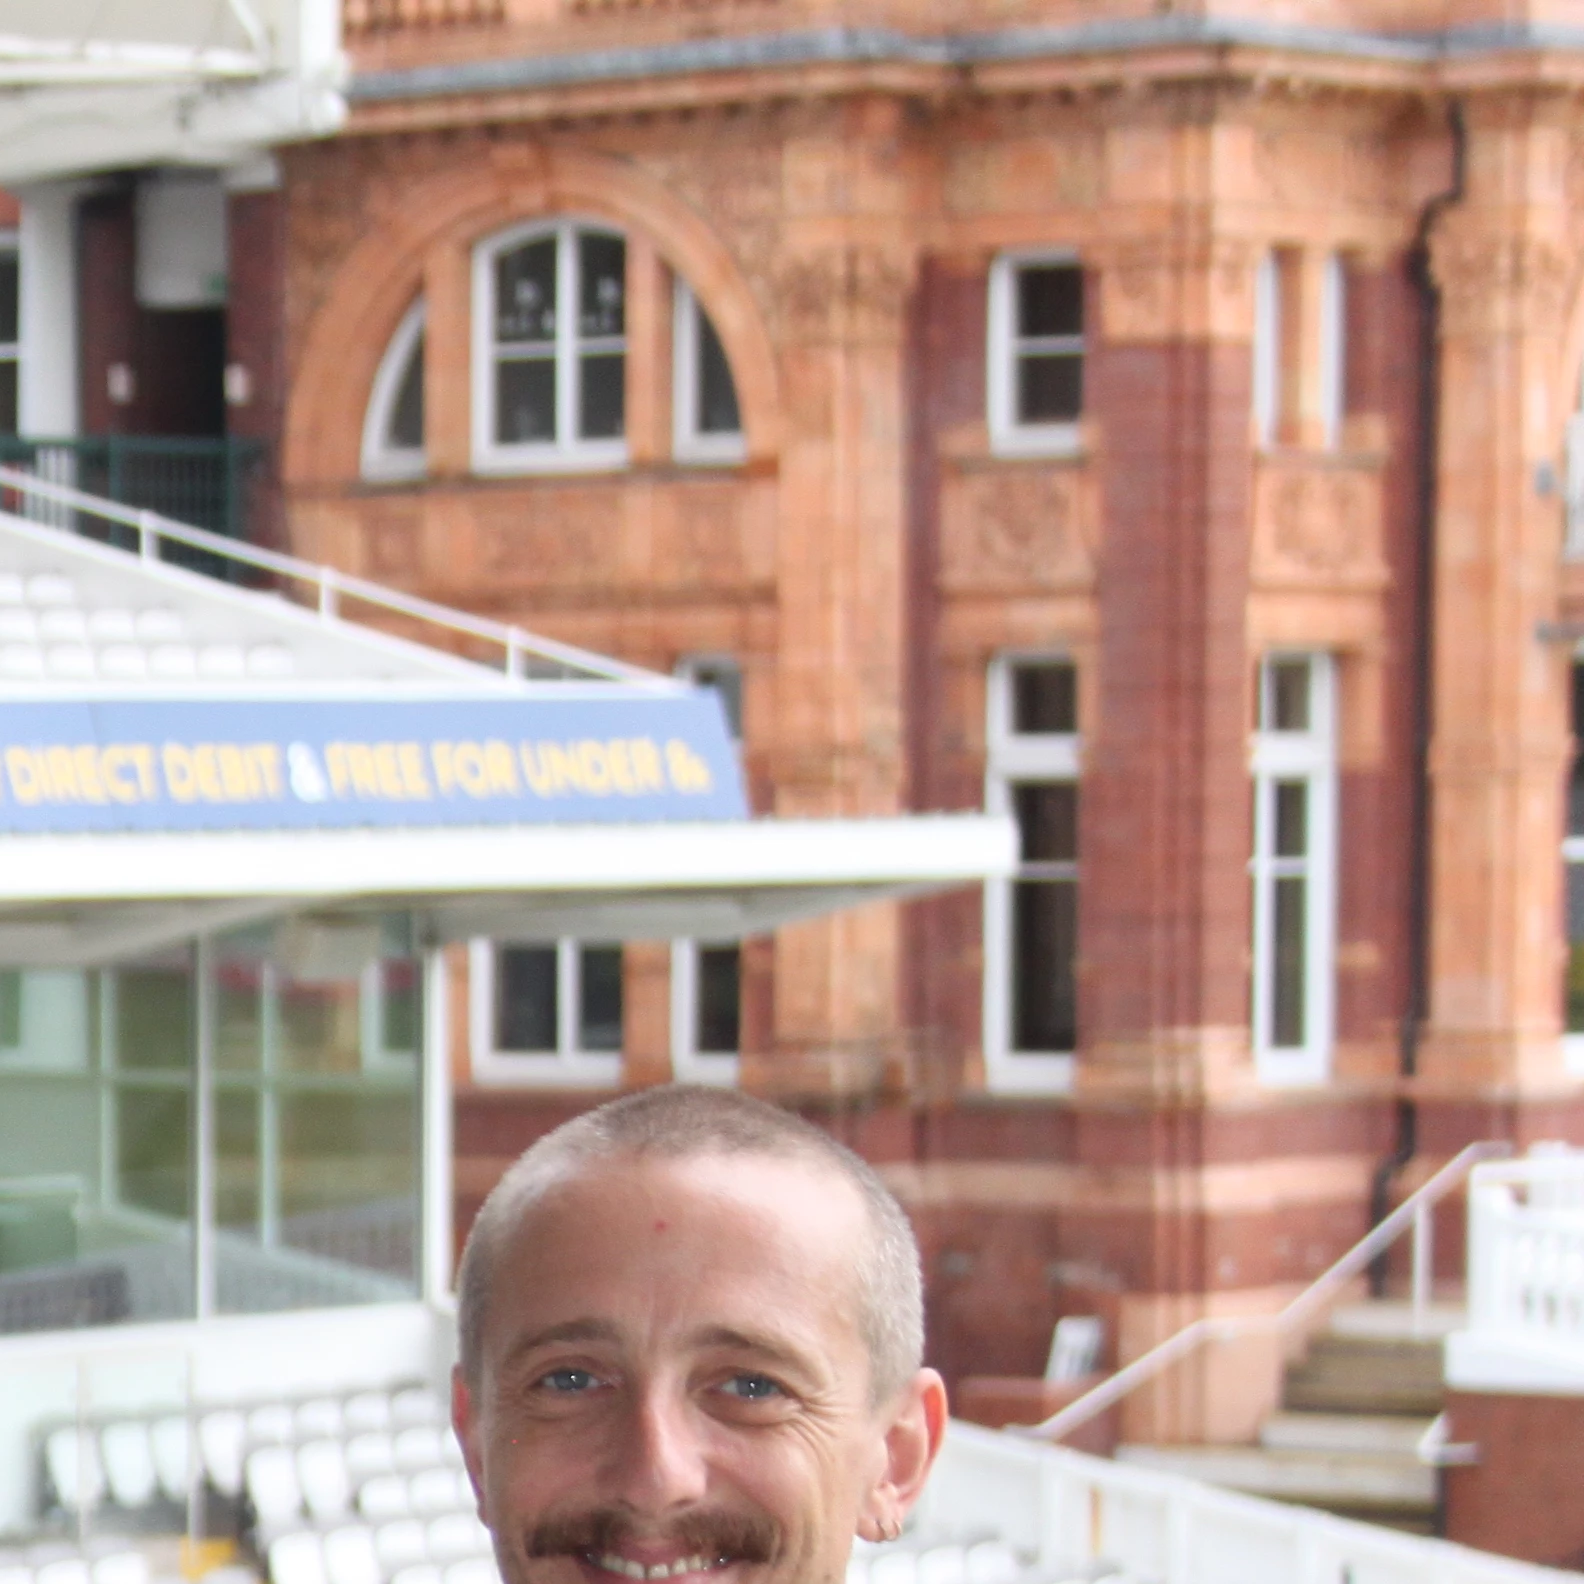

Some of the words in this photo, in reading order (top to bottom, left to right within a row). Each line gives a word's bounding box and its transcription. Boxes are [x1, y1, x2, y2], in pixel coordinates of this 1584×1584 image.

[3, 743, 156, 804] DIRECT
[161, 742, 284, 803] DEBIT
[324, 740, 431, 801] FREE
[430, 739, 520, 800] FOR
[519, 738, 666, 799] UNDER
